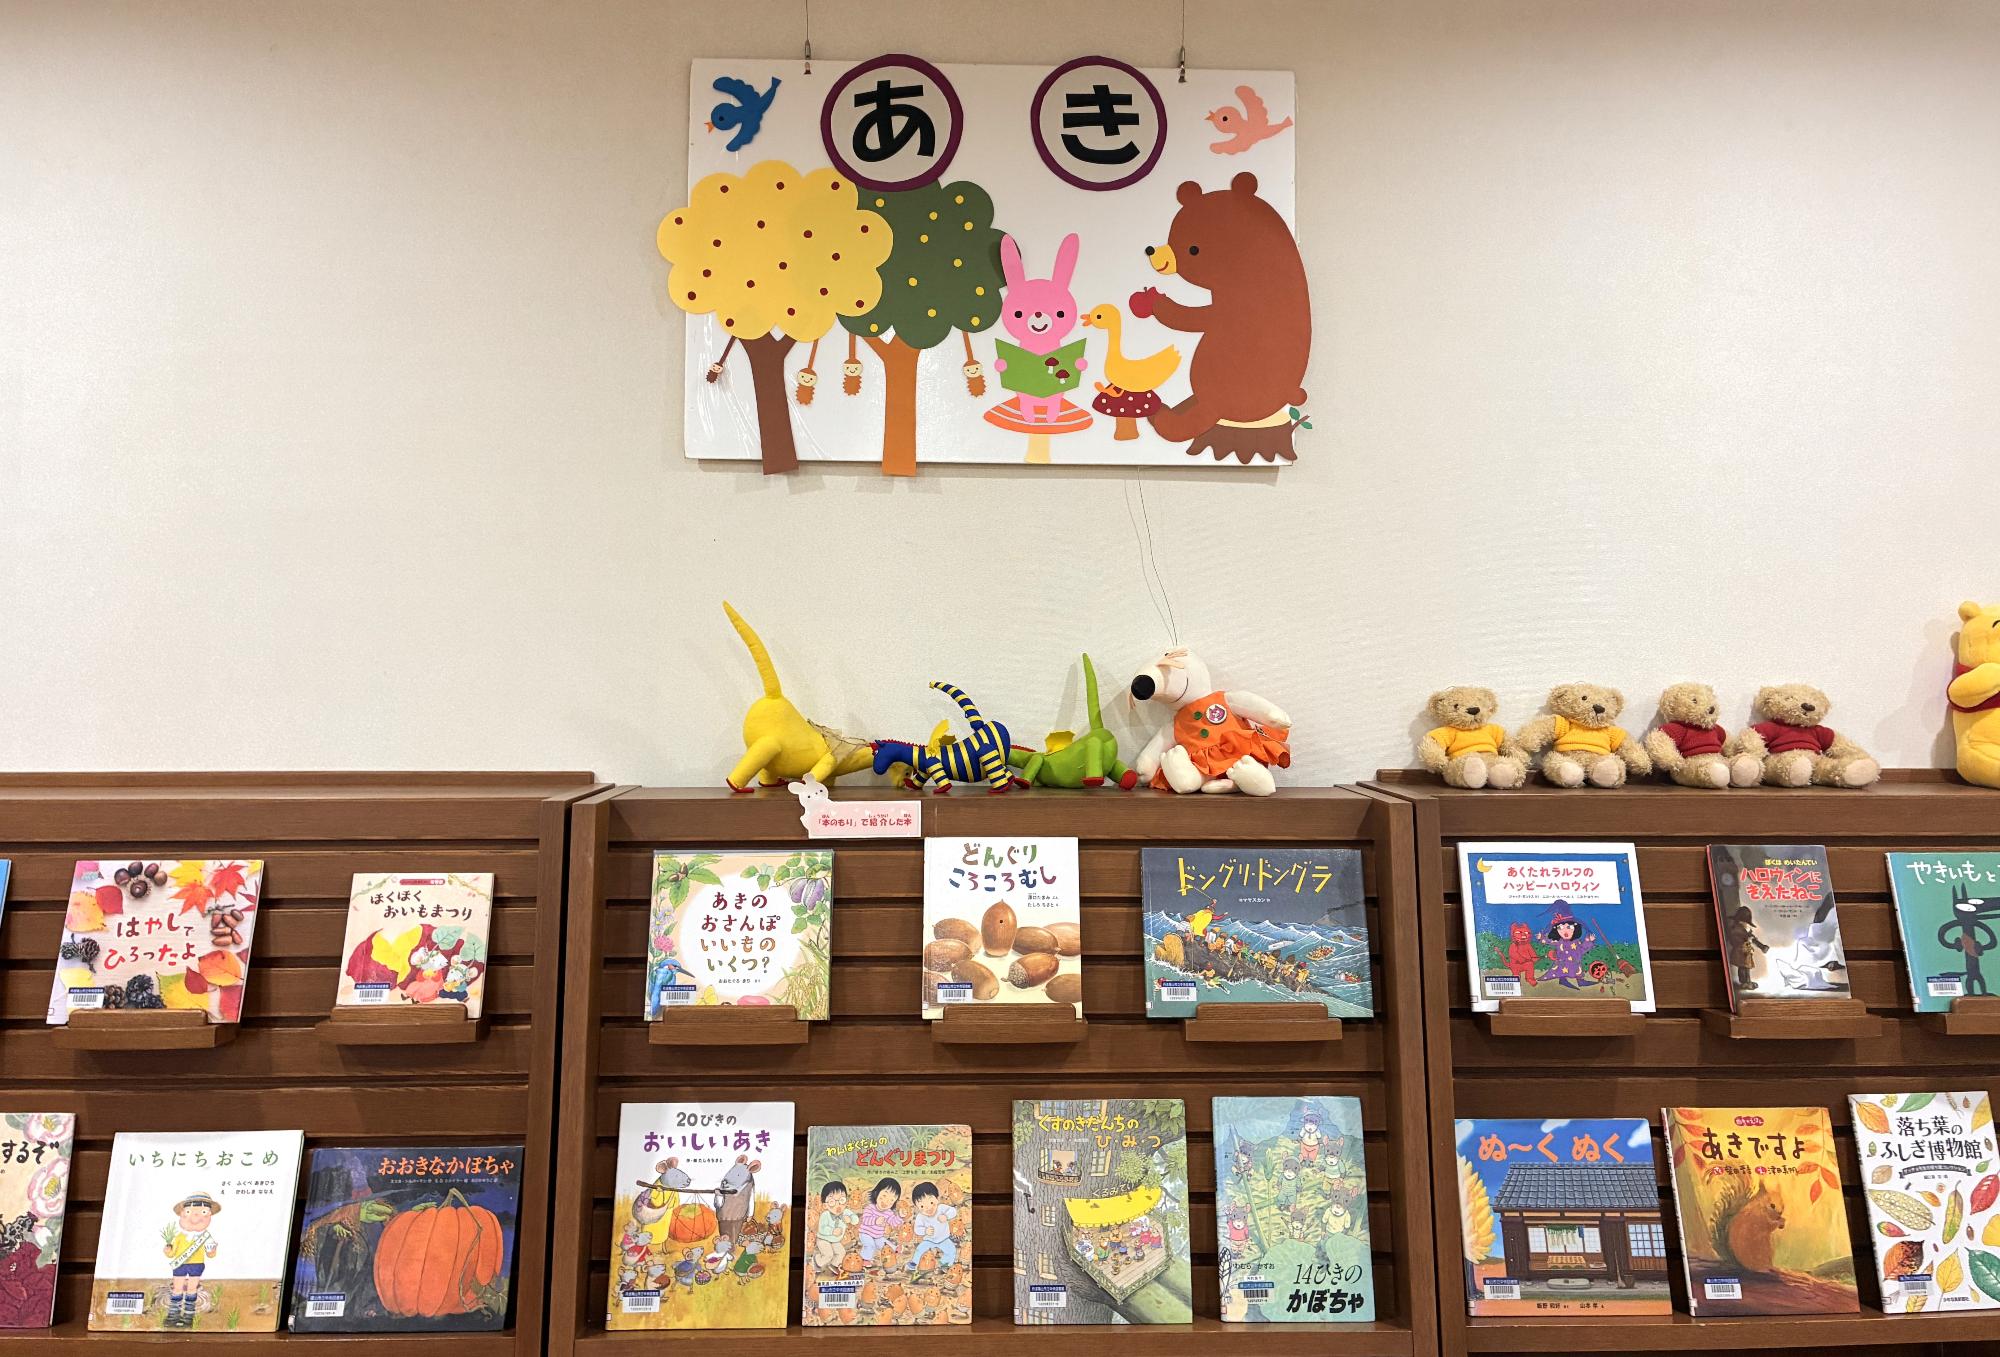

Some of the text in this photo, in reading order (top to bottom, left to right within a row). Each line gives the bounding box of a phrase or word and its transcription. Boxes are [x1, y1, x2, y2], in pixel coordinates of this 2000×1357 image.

[852, 80, 1140, 164] あ き
[962, 843, 1037, 868] どんぐり
[949, 866, 1057, 892] ころころむし
[1507, 866, 1594, 877] あくたれラルフの
[1740, 867, 1823, 884] ハロウィンに
[1906, 860, 2000, 885] やきいもと
[1503, 880, 1600, 892] ハッピーハロウィン
[1745, 882, 1822, 901] きえたねこ
[370, 890, 422, 905] ほくほく
[712, 891, 768, 910] あきの
[384, 904, 472, 920] おいもまつり
[117, 913, 195, 938] はやしで
[701, 914, 781, 932] おさんぽ
[700, 936, 776, 953] いいもの
[104, 943, 196, 970] ひろったよ
[706, 955, 770, 974] いくつ？
[1039, 1114, 1139, 1132] くすのきだんちの
[1896, 1115, 1963, 1137] 落ち葉の
[1, 1139, 60, 1165] するぞ
[643, 1130, 771, 1153] おいしいあき
[1572, 1132, 1625, 1163] ぬく
[1702, 1127, 1805, 1160] あきですよ
[1881, 1138, 1983, 1161] ふしぎ博物館
[129, 1150, 279, 1168] いちにちおこめ
[378, 1156, 514, 1175] おおきなかぼちゃ
[855, 1147, 955, 1167] どんぐりまつり
[1293, 1263, 1363, 1285] 14ひきの
[1286, 1288, 1364, 1313] かぼちゃ
